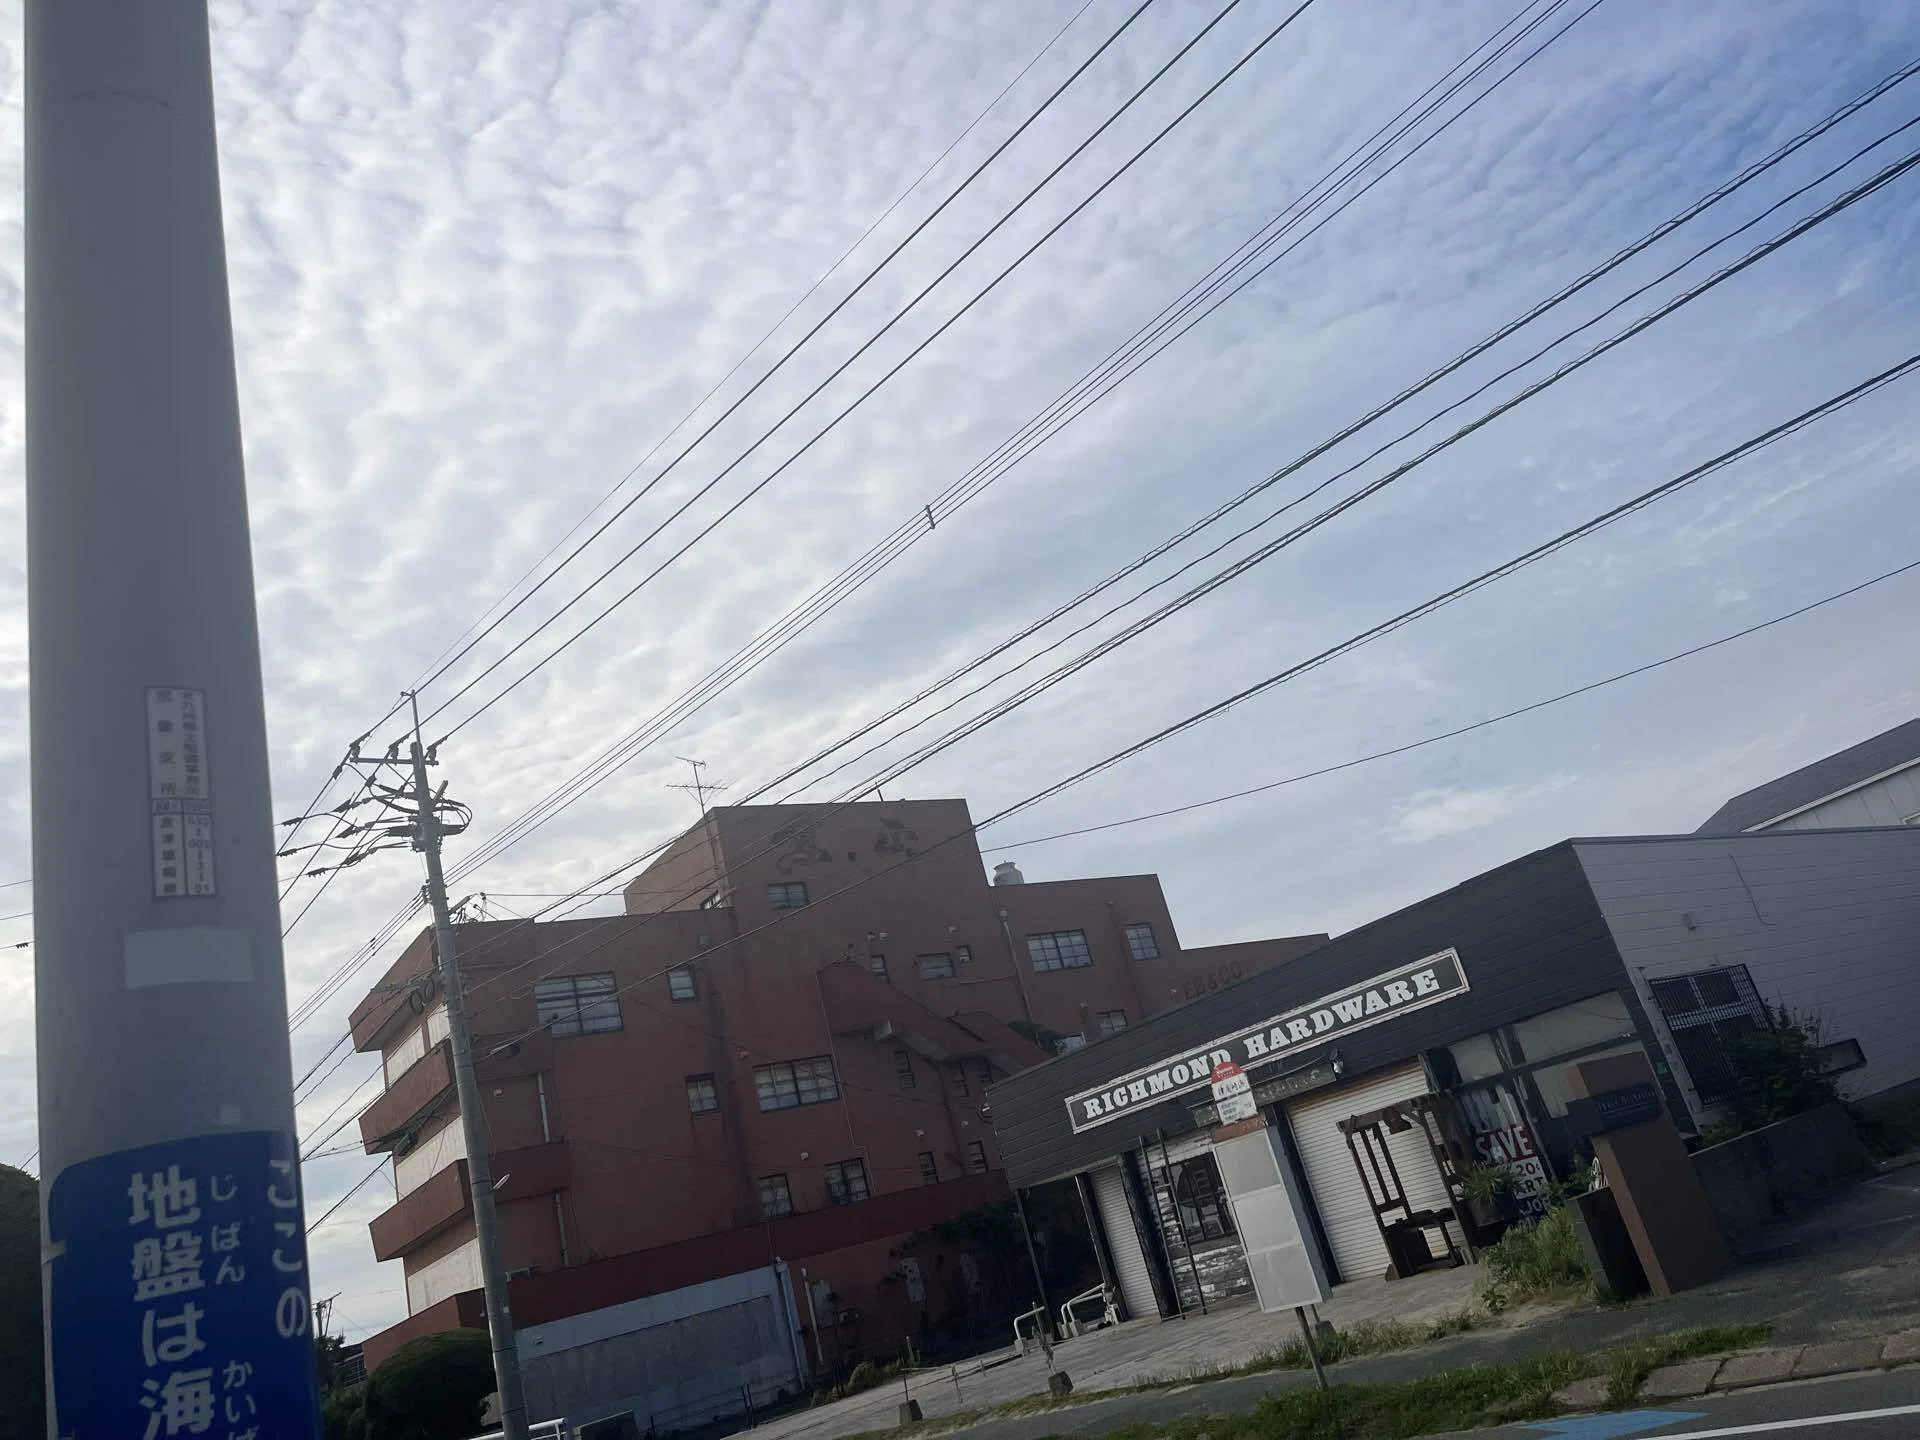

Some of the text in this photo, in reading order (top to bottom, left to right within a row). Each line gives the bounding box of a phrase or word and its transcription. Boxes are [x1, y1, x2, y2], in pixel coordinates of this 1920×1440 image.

[1084, 968, 1440, 1119] RICHMOND HARDWARE
[1475, 1125, 1534, 1164] SAVE
[210, 1173, 246, 1286] じばん
[267, 1159, 307, 1339] ここの
[127, 1164, 216, 1440] 地盤は海
[222, 1359, 260, 1440] かい
